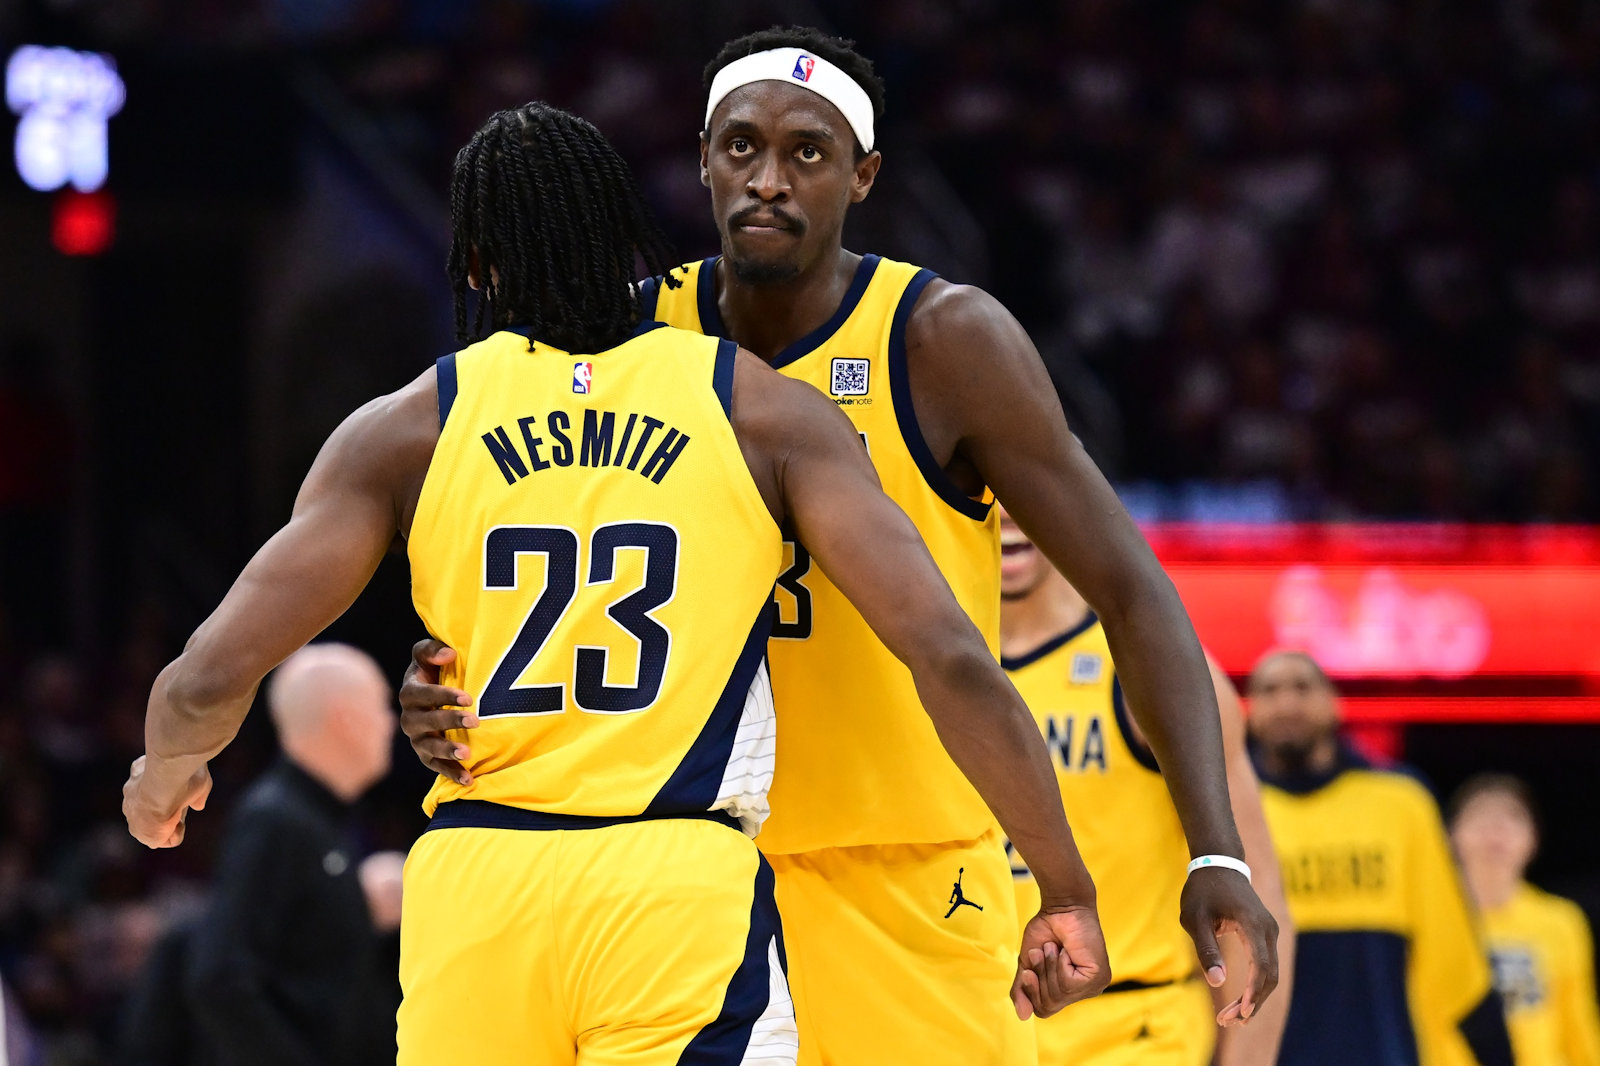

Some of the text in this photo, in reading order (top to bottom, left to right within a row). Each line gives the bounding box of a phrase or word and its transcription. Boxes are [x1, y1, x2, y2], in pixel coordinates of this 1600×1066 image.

[832, 397, 872, 405] okenote
[481, 409, 691, 486] NESMITH
[476, 519, 681, 719] 23
[1046, 714, 1108, 772] NA
